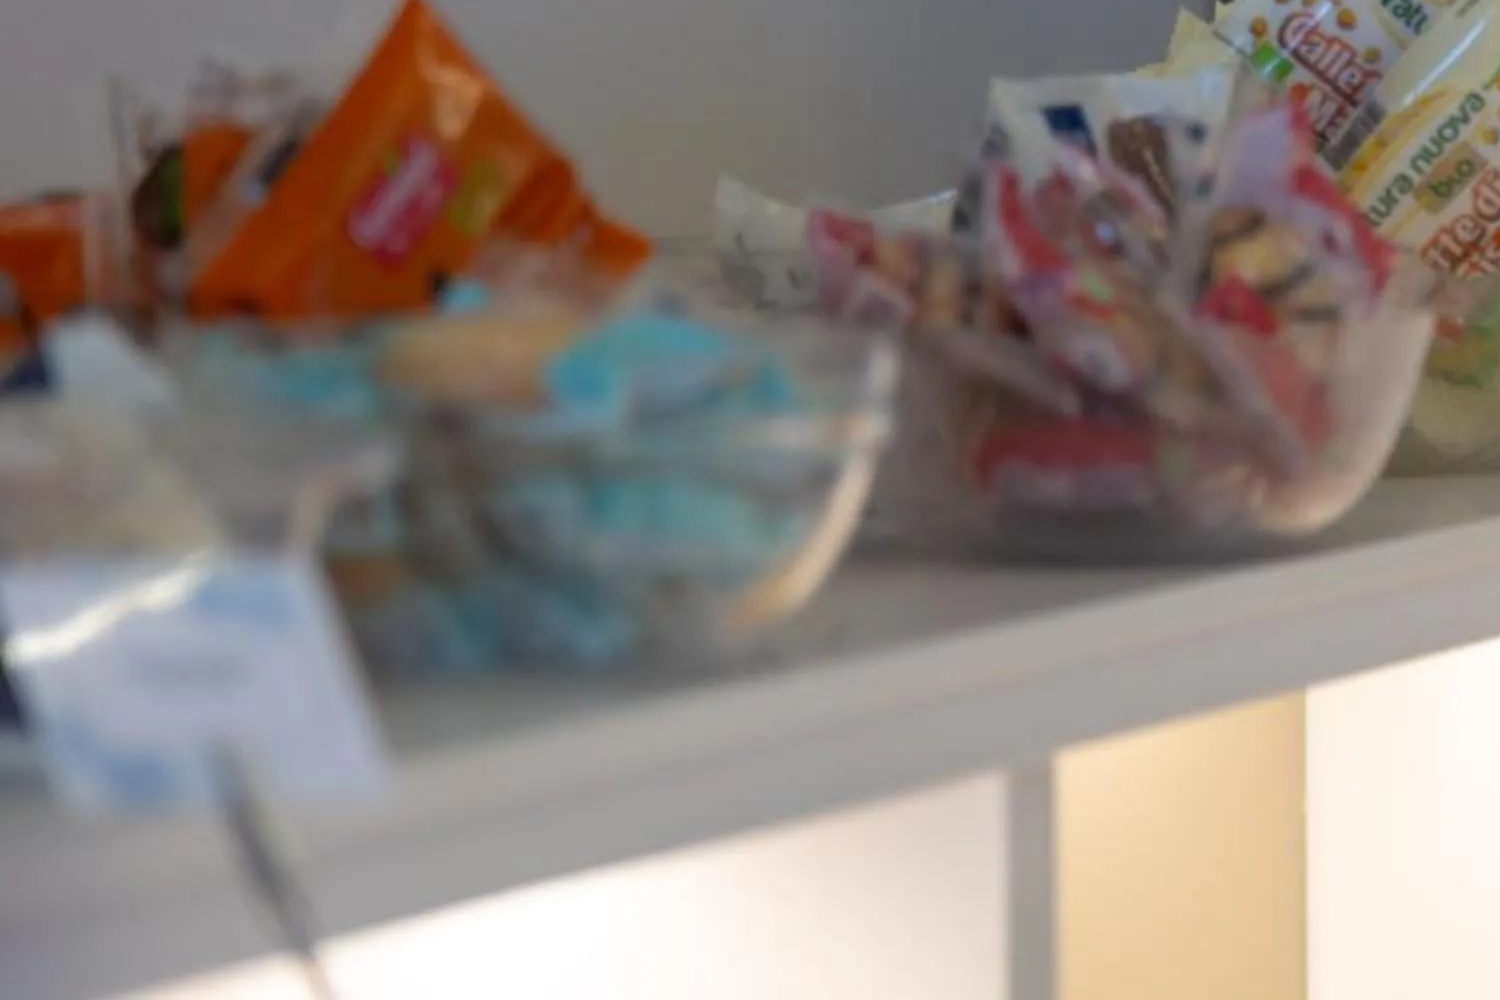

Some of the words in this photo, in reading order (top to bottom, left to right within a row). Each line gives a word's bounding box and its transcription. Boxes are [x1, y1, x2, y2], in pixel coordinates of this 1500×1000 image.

[1279, 11, 1377, 97] Galle
[1410, 92, 1485, 175] nuova
[1428, 158, 1475, 198] bio
